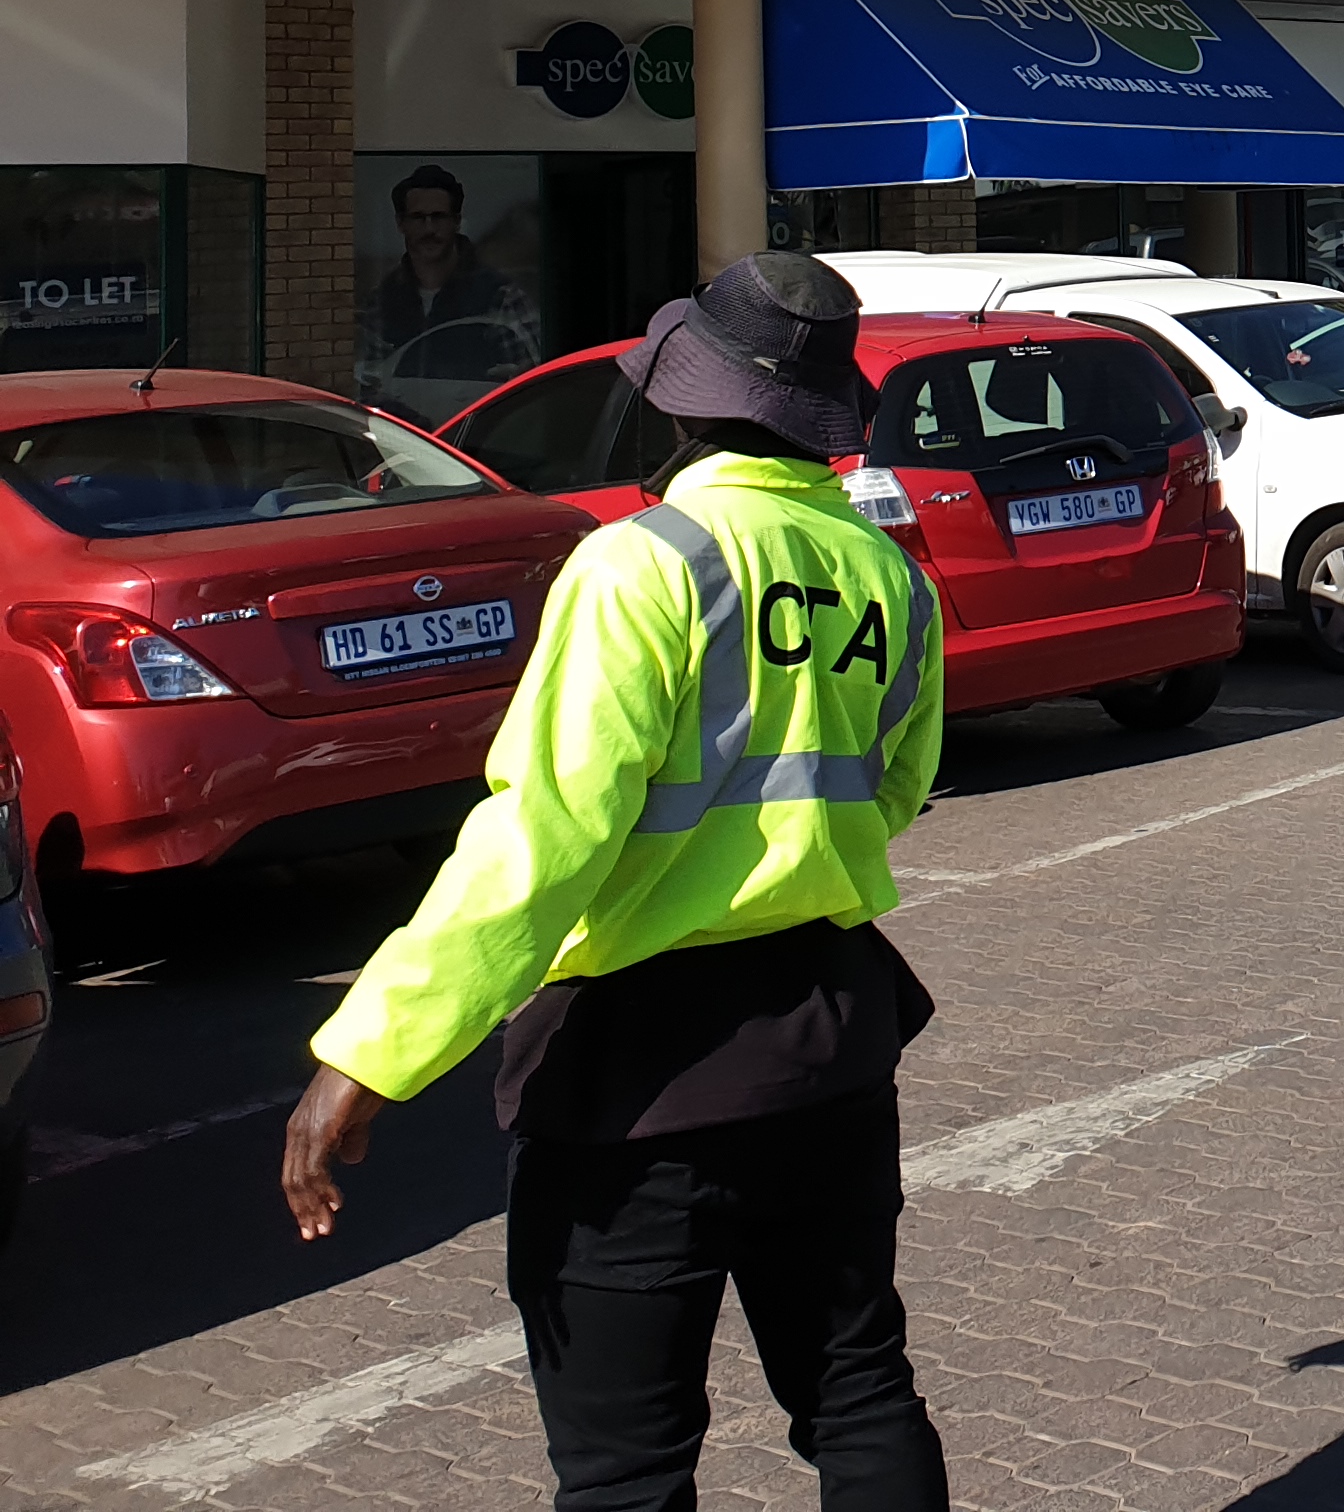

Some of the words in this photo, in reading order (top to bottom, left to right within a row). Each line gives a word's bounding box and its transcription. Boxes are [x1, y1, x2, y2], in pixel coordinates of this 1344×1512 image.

[639, 60, 694, 83] sav
[1012, 62, 1050, 90] For
[1051, 73, 1177, 95] AFFORDABLE
[1183, 82, 1221, 98] EYE
[1222, 84, 1273, 100] CARE
[19, 279, 69, 309] TO
[84, 276, 136, 306] LET
[1015, 501, 1050, 528] YGW
[1061, 494, 1096, 522] 580
[1115, 489, 1136, 513] GP
[172, 606, 262, 631] ALMERA
[331, 627, 368, 662] HD
[380, 622, 413, 653] 61
[423, 614, 454, 647] SS
[475, 605, 506, 638] GP
